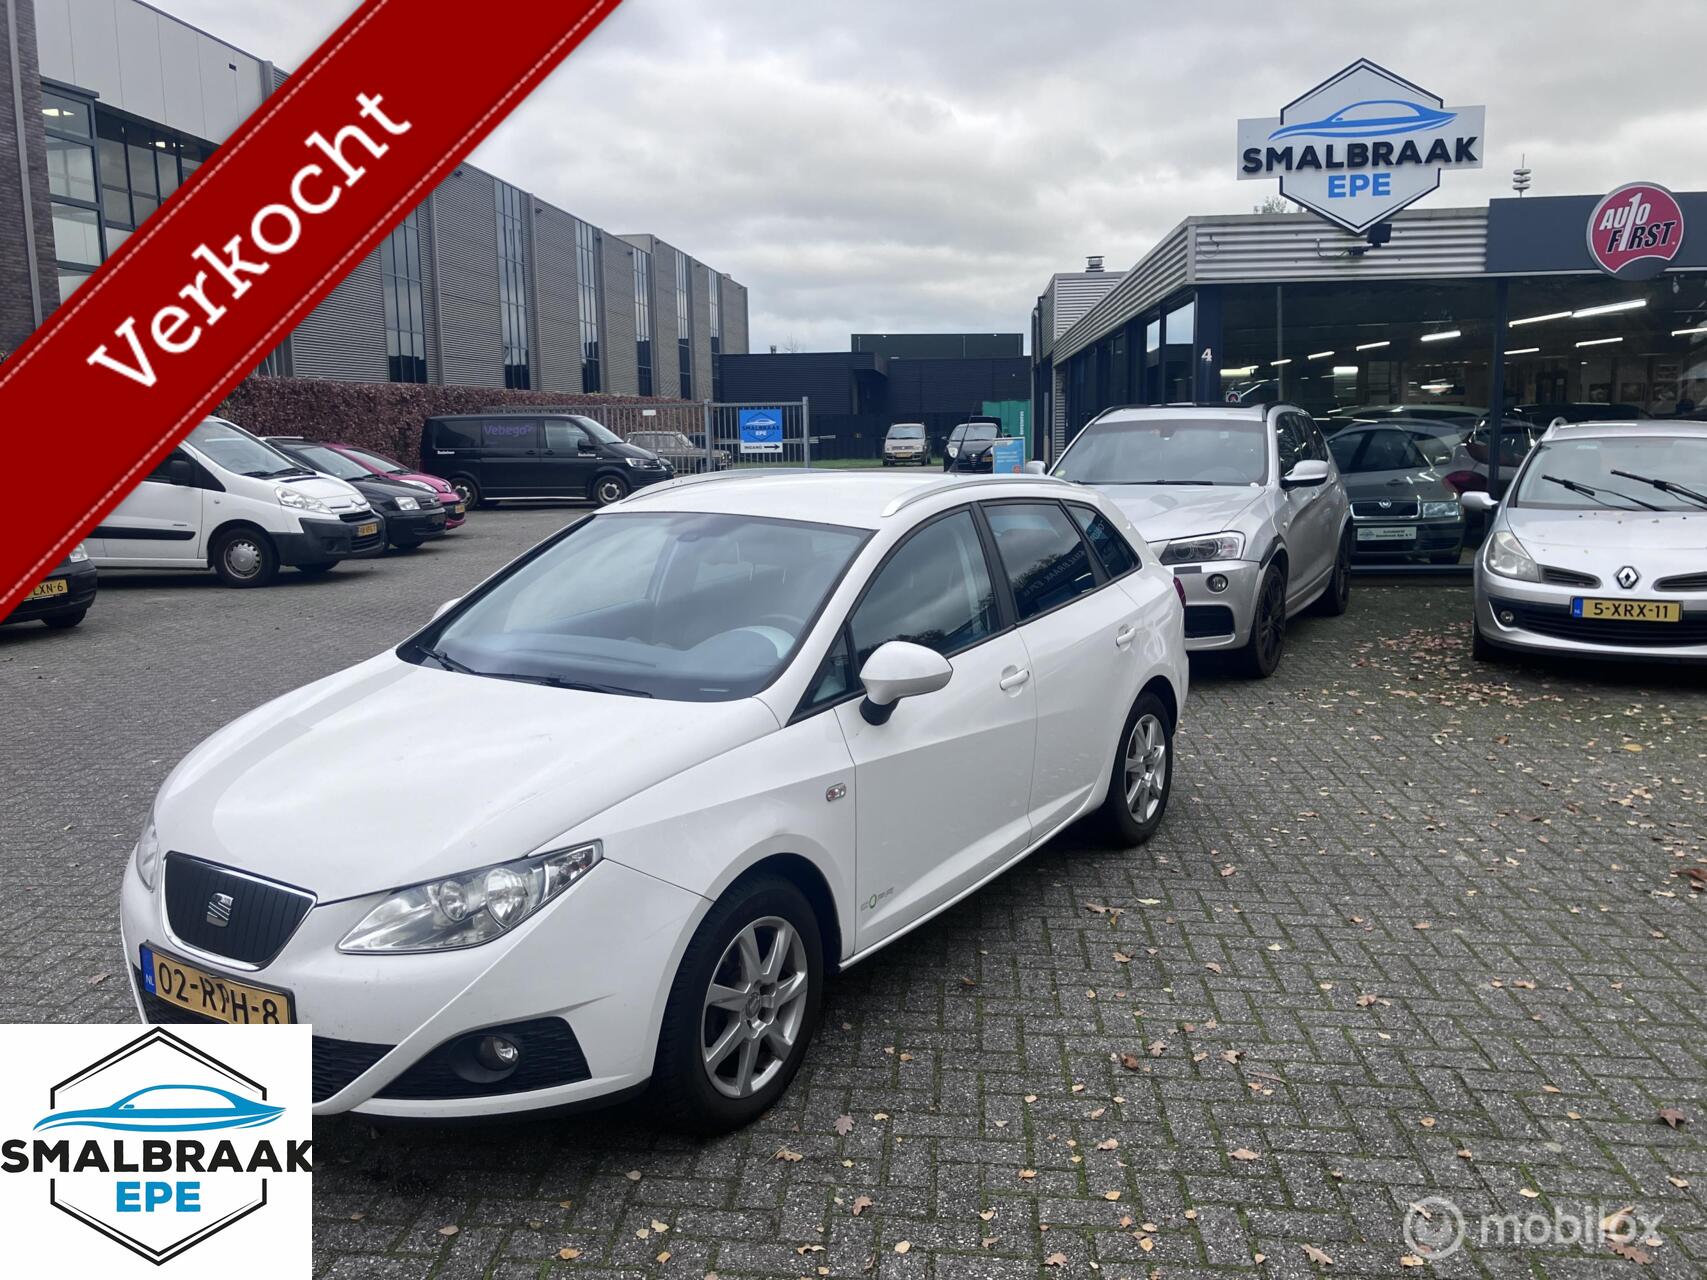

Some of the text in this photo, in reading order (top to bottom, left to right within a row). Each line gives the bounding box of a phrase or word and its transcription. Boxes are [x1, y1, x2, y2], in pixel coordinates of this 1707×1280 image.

[1242, 136, 1478, 173] SMALBRAAK
[1328, 172, 1391, 198] EPE
[1201, 348, 1213, 361] 4
[1593, 602, 1668, 619] 5-XRX-11
[145, 974, 155, 987] NL
